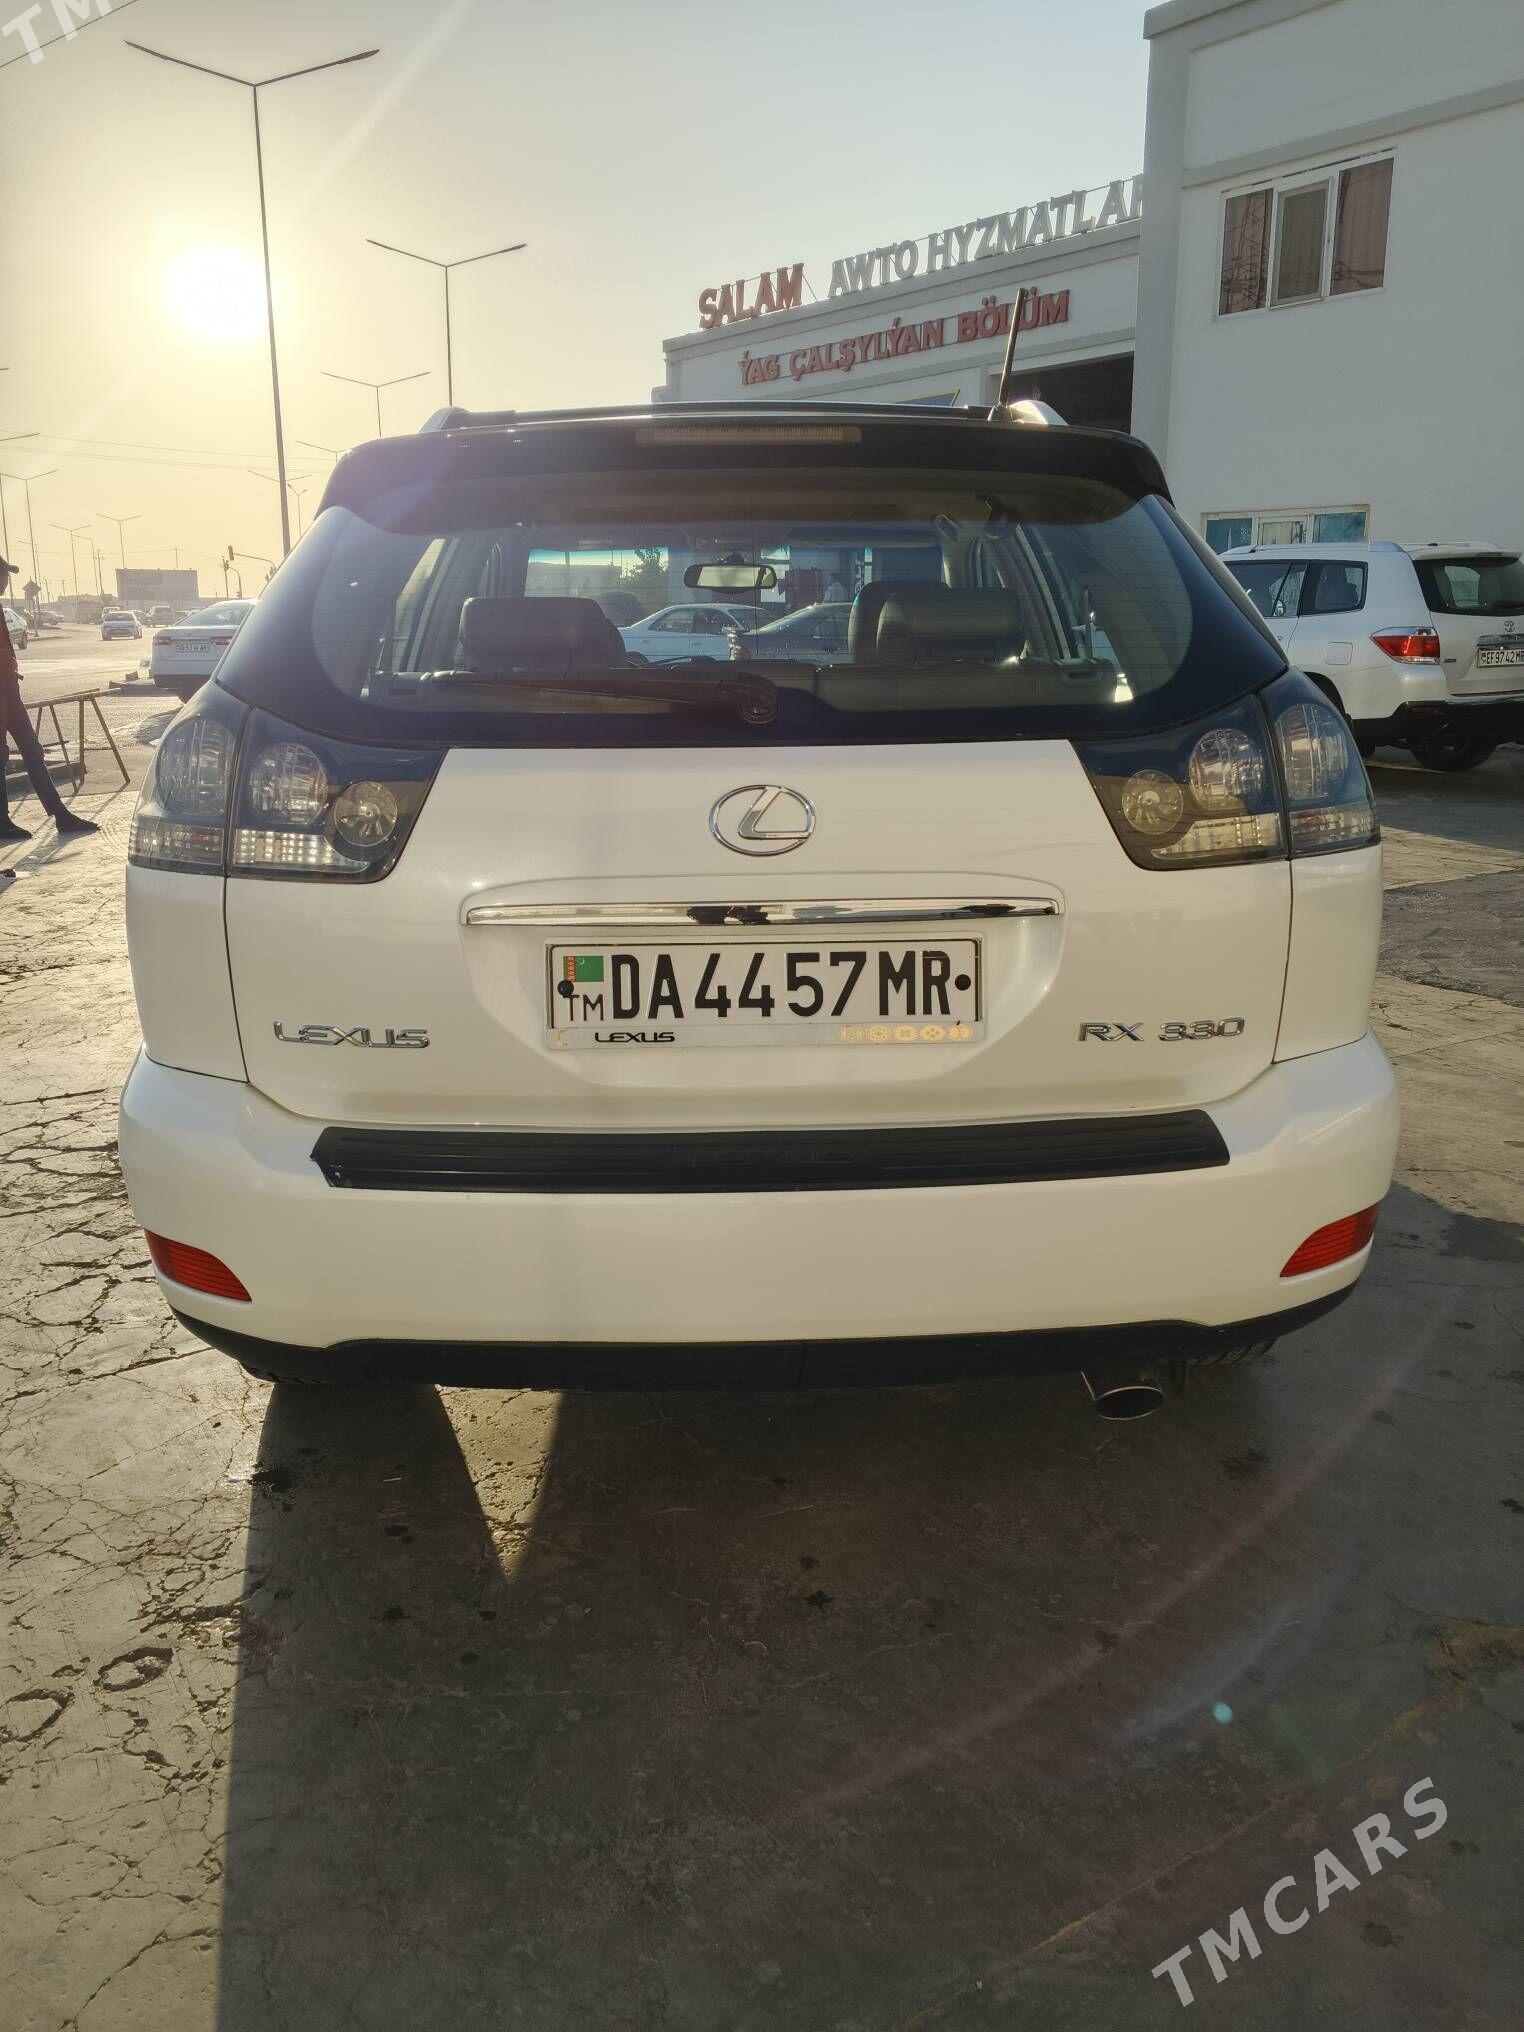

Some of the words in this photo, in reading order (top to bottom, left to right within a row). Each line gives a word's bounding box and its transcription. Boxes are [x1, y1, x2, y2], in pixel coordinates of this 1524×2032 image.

[699, 263, 804, 329] SALAM
[828, 240, 919, 299] AWTO
[957, 286, 1070, 343] BÖLÜM
[565, 994, 604, 1021] TM
[611, 951, 951, 1019] DA4457MR
[273, 1021, 430, 1048] LEXUS
[594, 1031, 675, 1043] LEXUS
[1078, 1022, 1144, 1041] RX
[1158, 1017, 1244, 1041] 330
